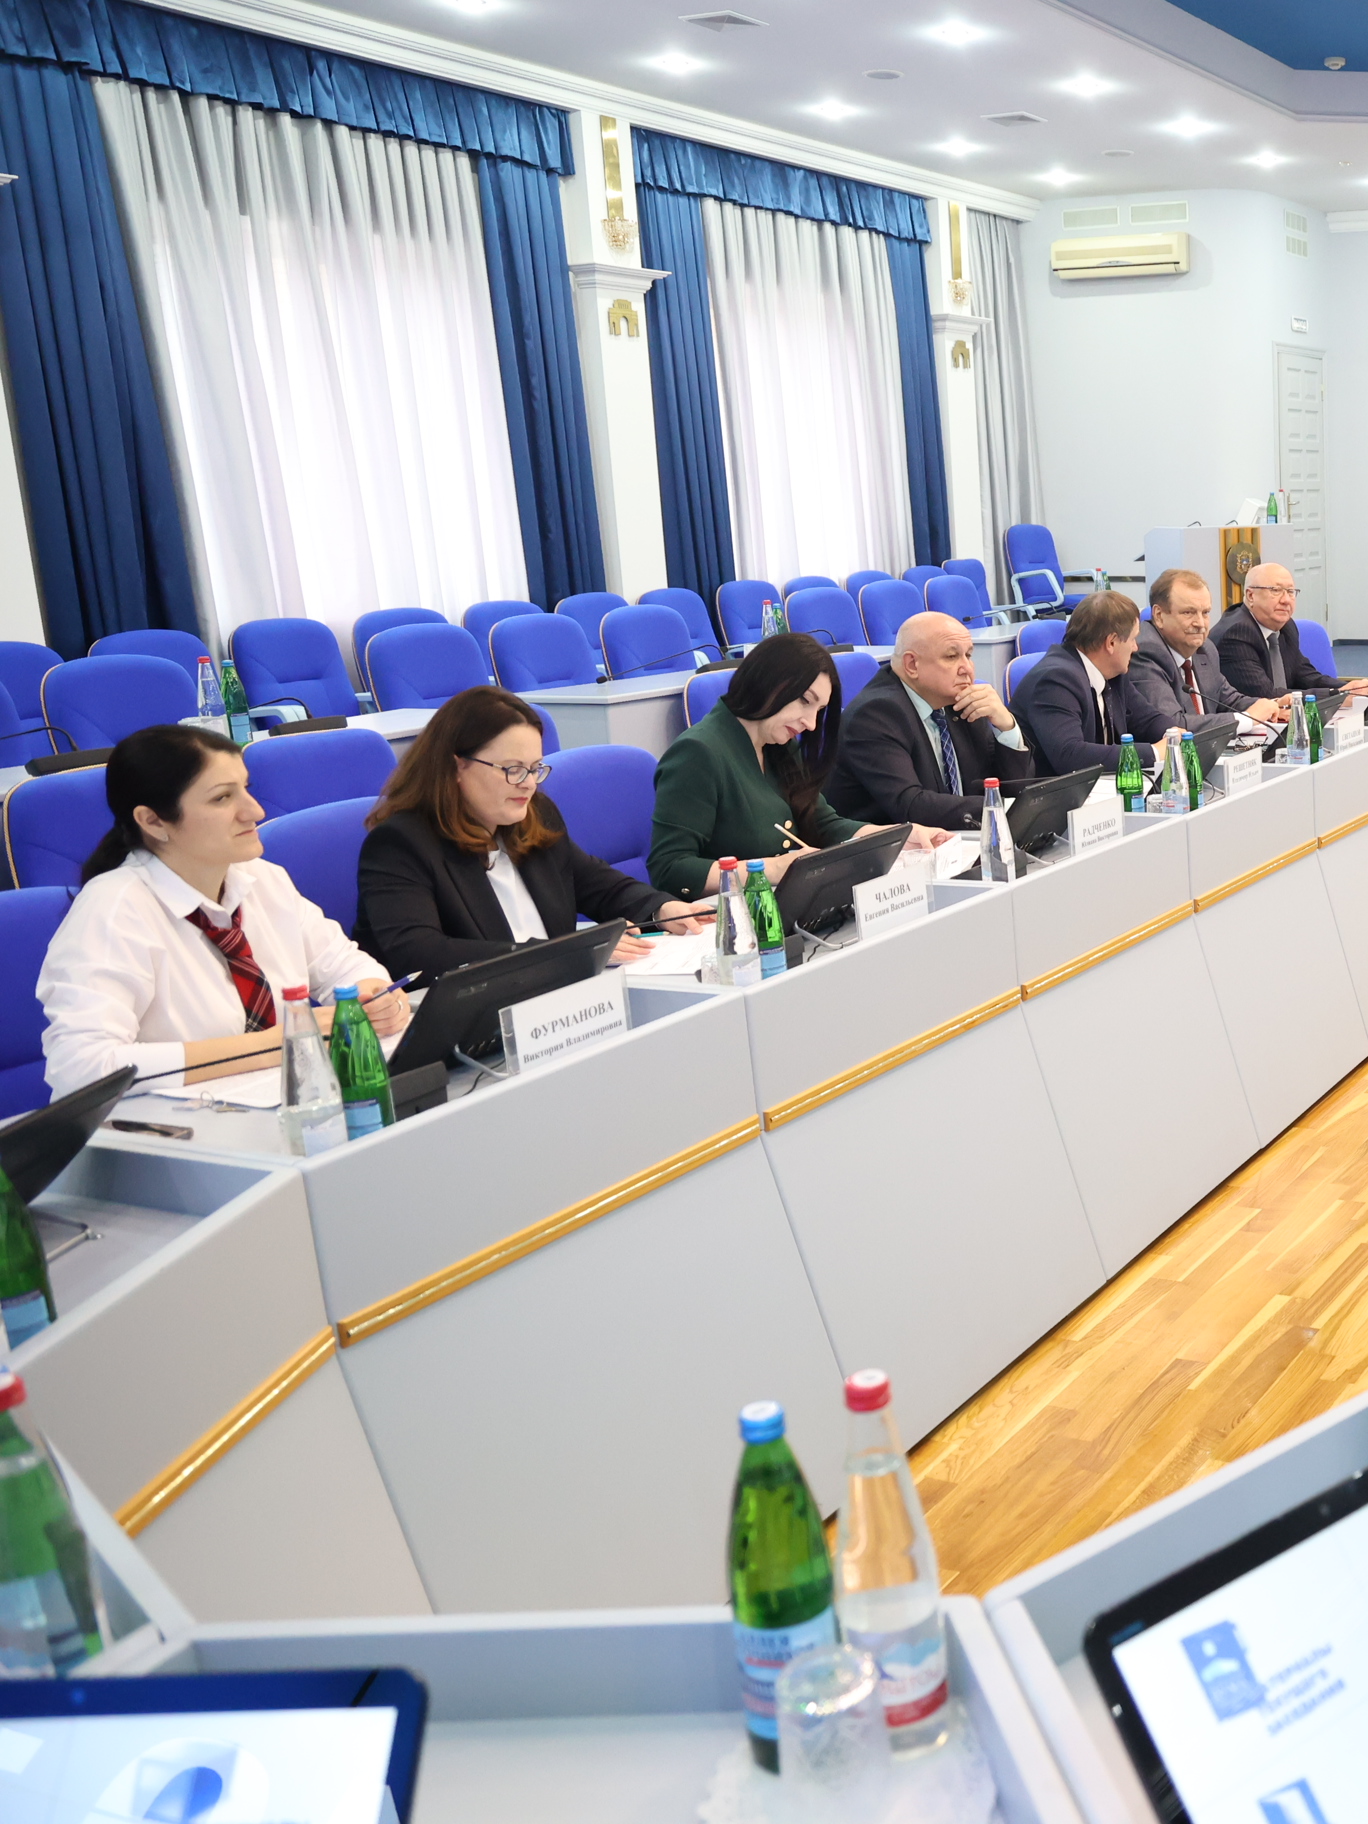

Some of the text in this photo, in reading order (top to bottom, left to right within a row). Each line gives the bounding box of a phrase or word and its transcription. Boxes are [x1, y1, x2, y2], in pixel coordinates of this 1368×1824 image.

[1082, 818, 1116, 837] РАДЧЕНКО
[875, 883, 911, 903] ЧАЛОВА
[864, 894, 924, 922] Евгения Васильевна
[530, 1000, 614, 1040] ФУРМАНОВА
[523, 1019, 623, 1064] Виктория Владимировна
